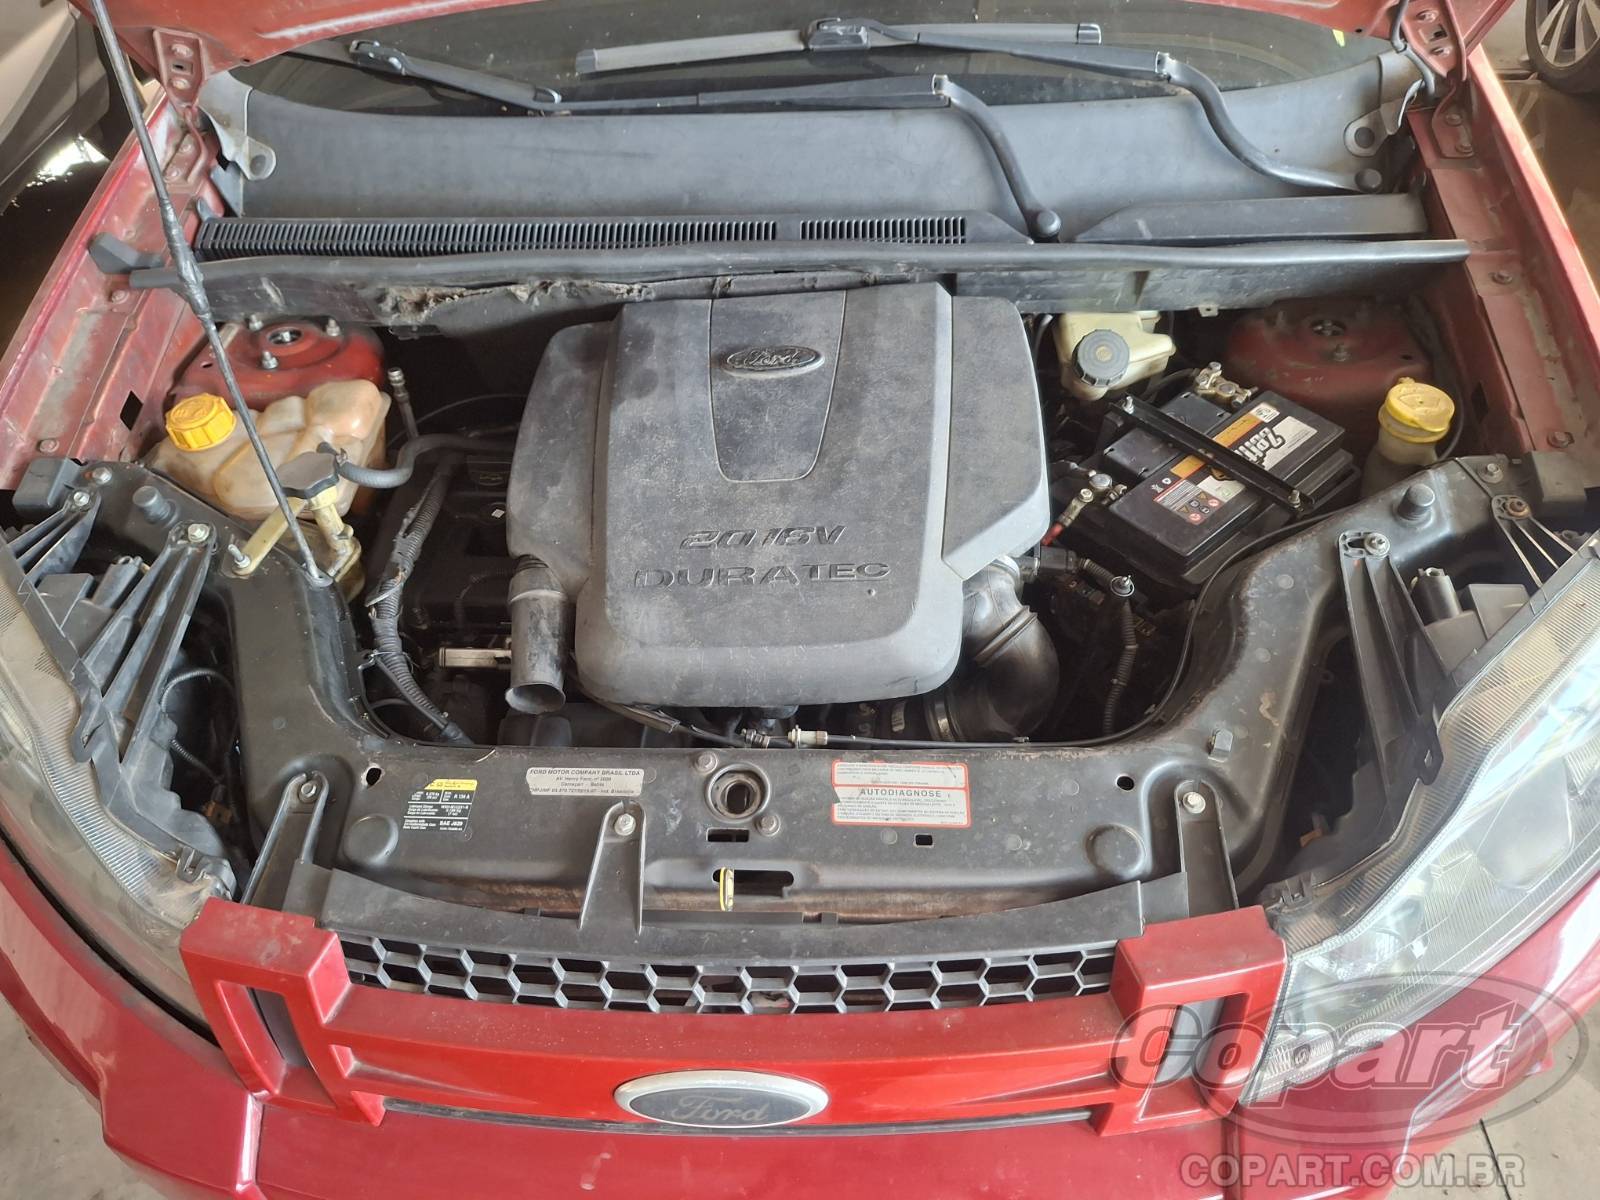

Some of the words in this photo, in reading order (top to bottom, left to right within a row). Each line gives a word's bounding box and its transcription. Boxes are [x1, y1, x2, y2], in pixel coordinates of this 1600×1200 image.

[744, 347, 801, 367] Ford
[633, 562, 892, 588] DURATEC
[860, 788, 942, 798] AUTODIAGNOSE
[671, 1095, 769, 1121] Ford
